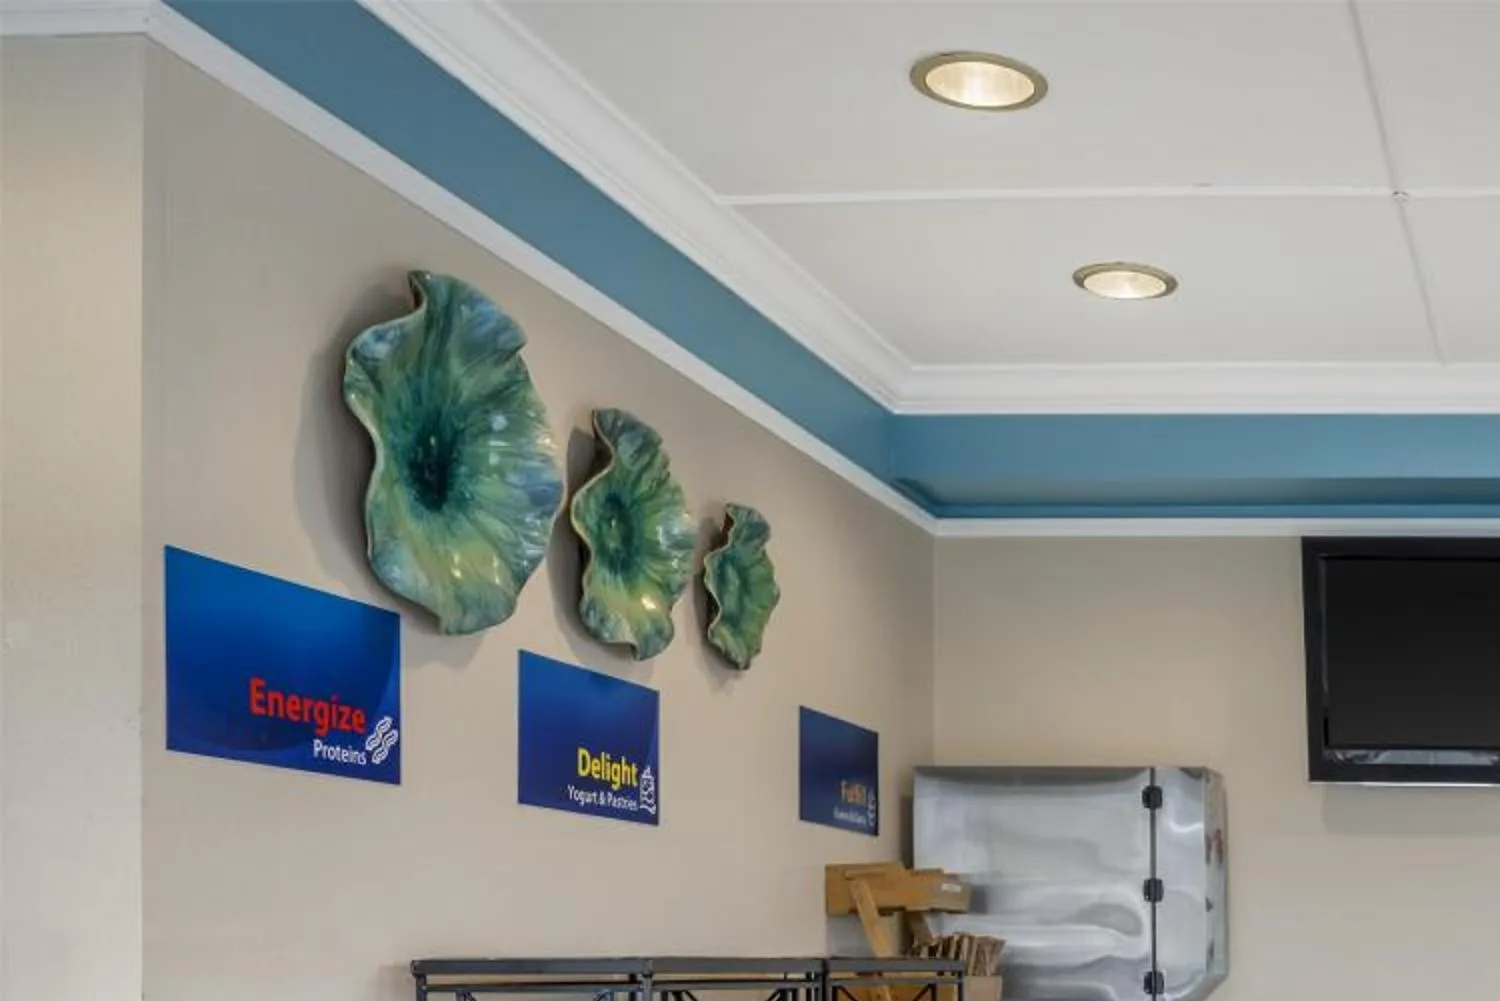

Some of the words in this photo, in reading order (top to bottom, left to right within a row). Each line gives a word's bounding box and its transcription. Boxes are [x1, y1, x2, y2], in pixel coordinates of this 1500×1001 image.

[249, 676, 366, 737] Energize
[313, 738, 367, 765] Proteins
[577, 747, 638, 791] Delight
[567, 784, 598, 807] Yogurt
